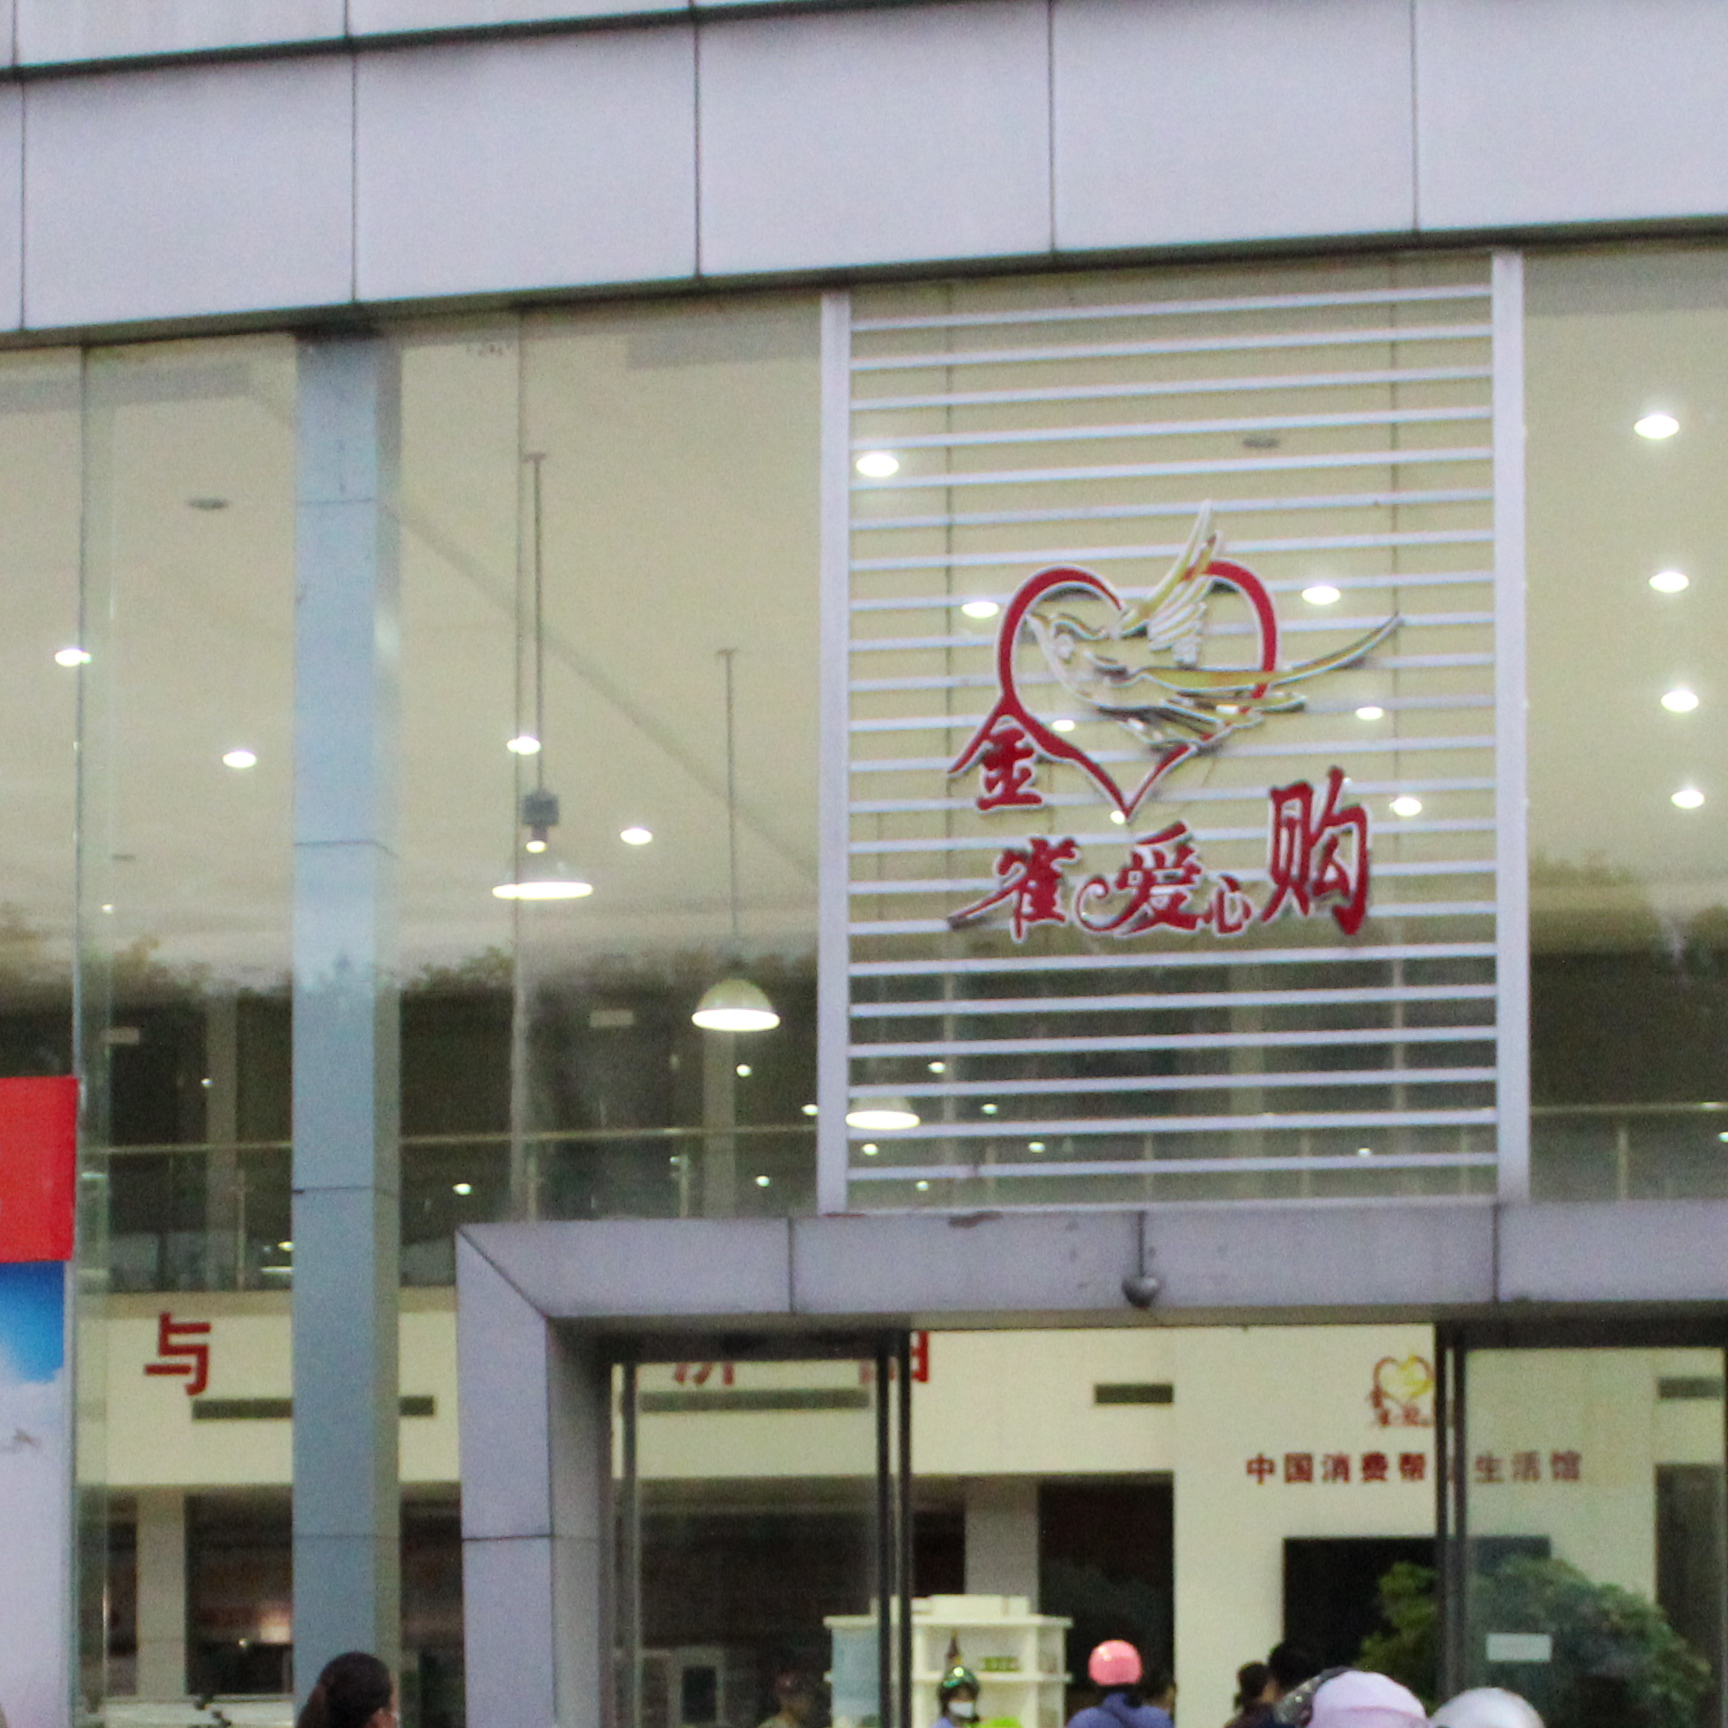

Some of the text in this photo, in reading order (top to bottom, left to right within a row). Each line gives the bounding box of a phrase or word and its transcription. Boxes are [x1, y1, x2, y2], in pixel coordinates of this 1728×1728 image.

[144, 1311, 213, 1397] 与
[1245, 1449, 1581, 1485] 中国消费帮生活馆
